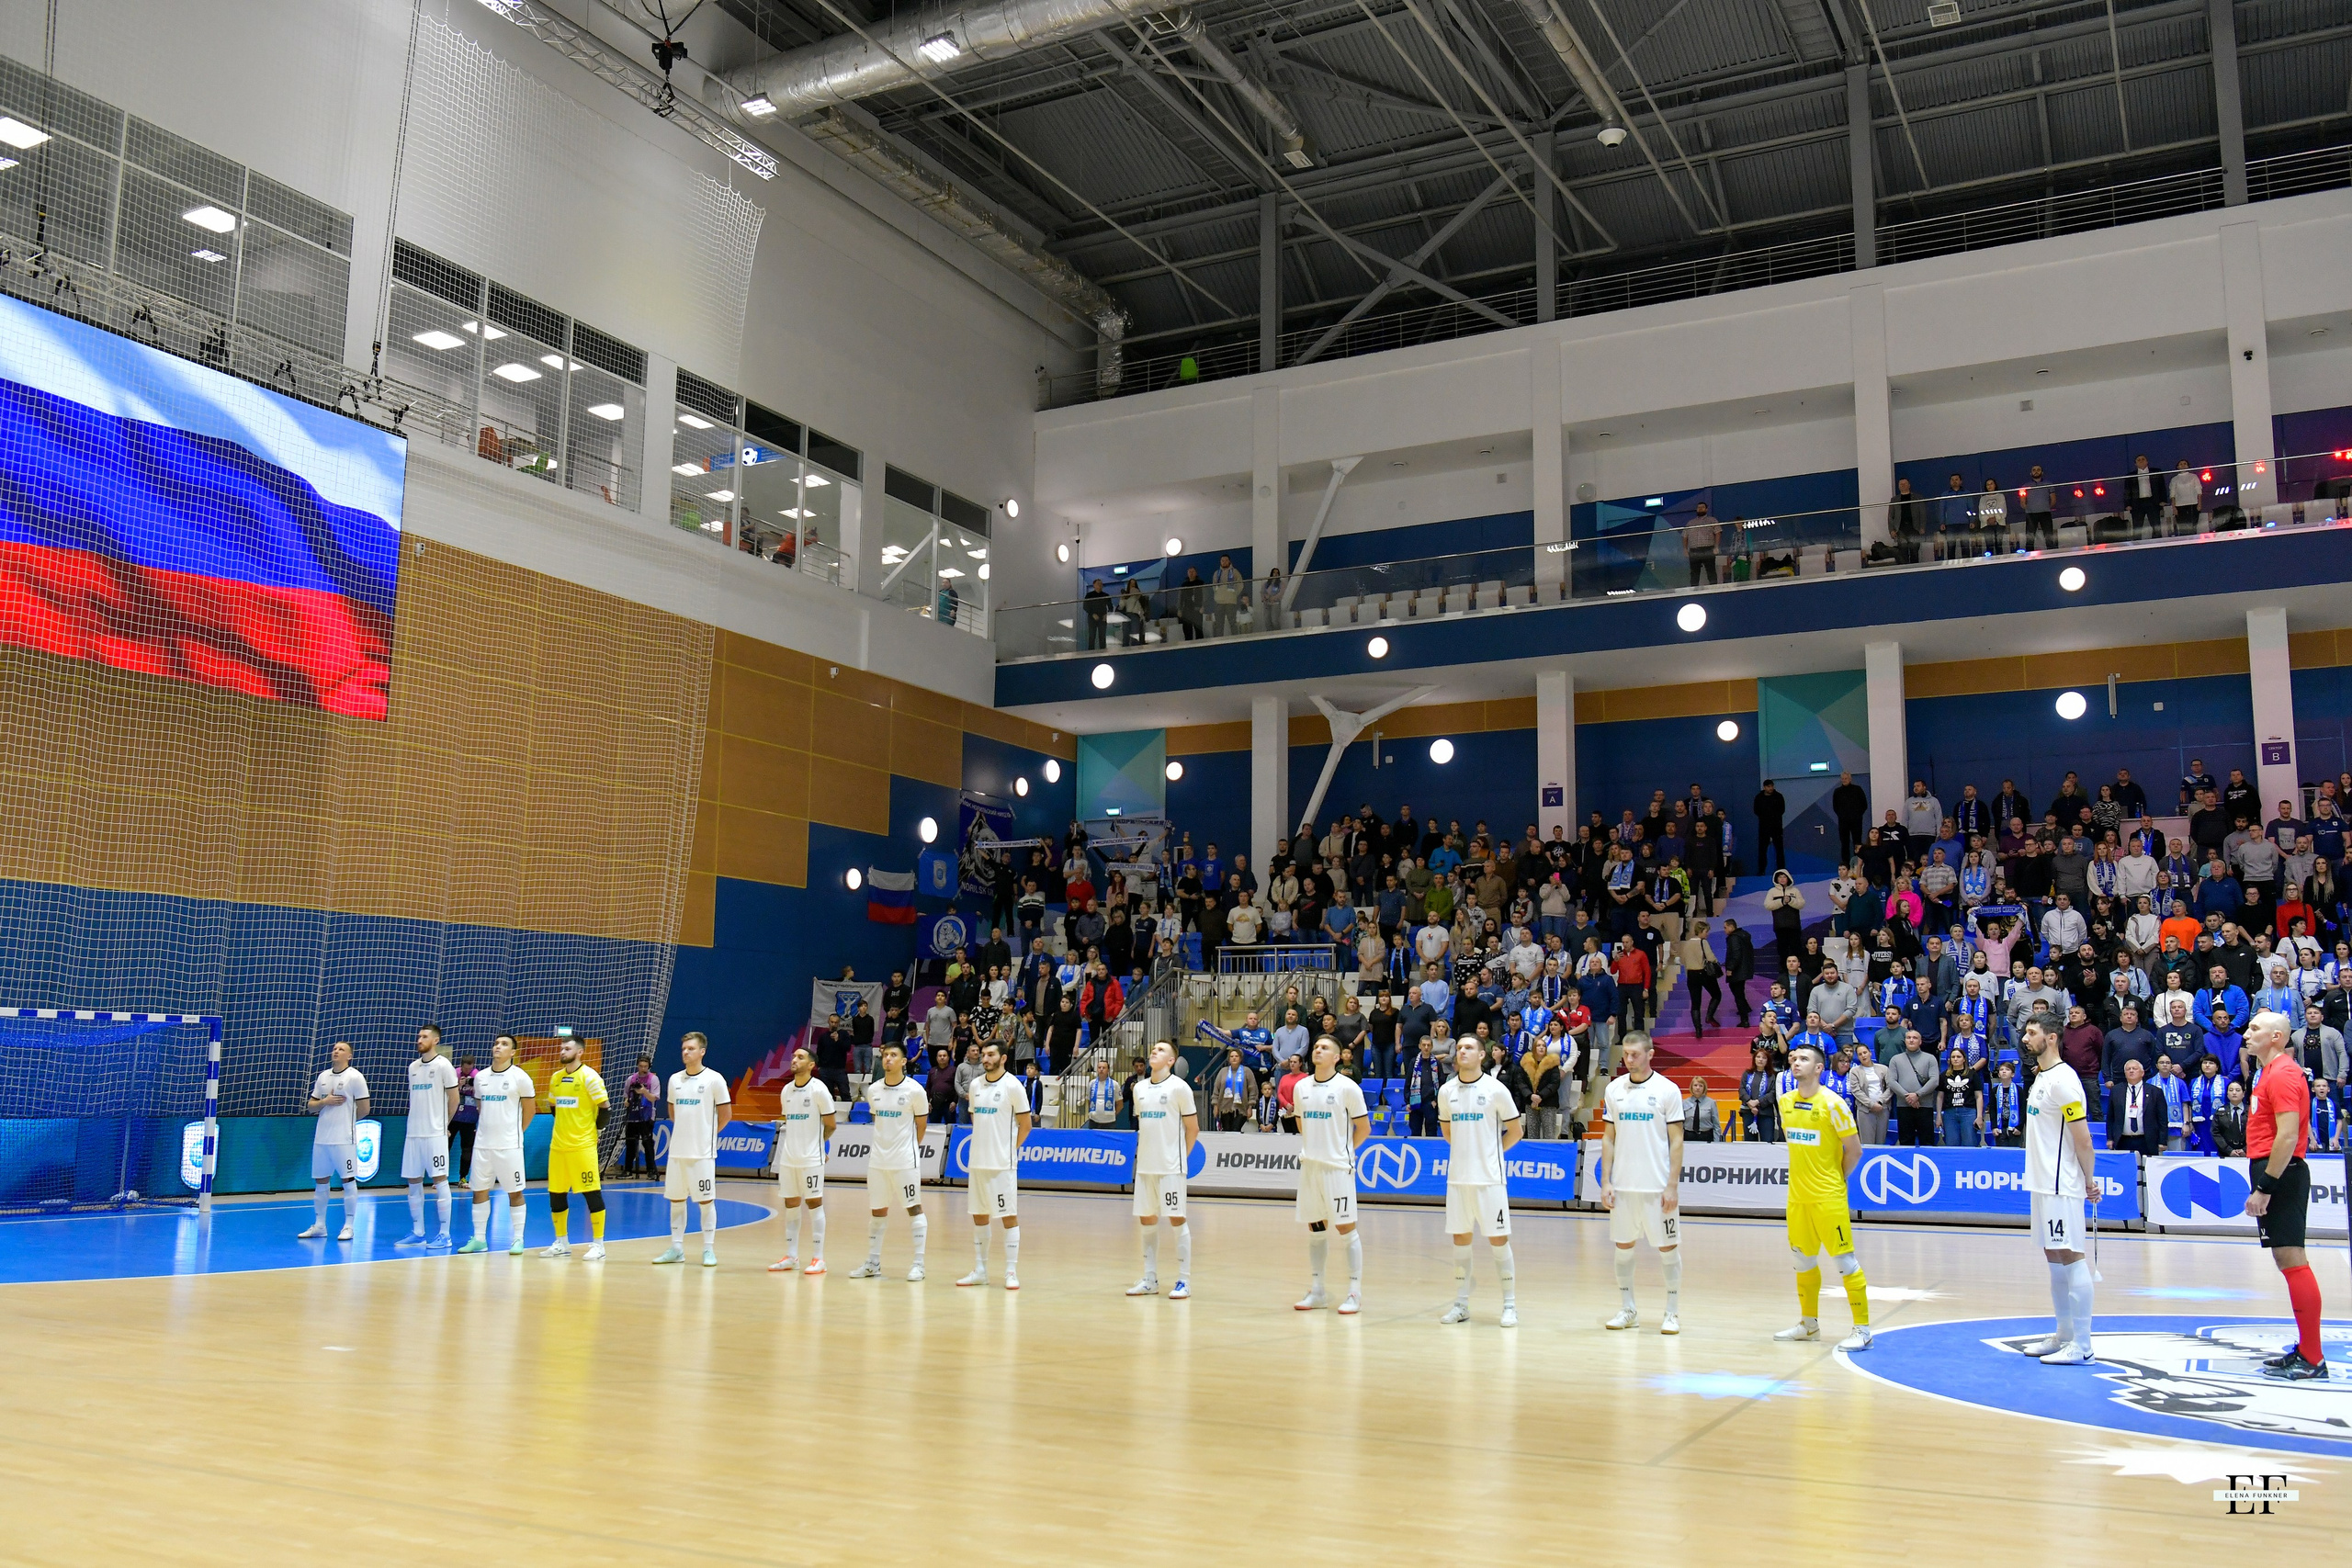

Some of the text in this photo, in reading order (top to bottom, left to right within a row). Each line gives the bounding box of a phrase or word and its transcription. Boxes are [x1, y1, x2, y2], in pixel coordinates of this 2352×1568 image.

[961, 881, 987, 895] NORILSK
[1140, 1111, 1166, 1119] СИБУР
[1303, 1111, 1332, 1120] СИБУР
[1452, 1112, 1484, 1122] СИБУР
[1619, 1111, 1654, 1122] СИБУР
[1787, 1131, 1816, 1142] СИБУР
[717, 1136, 765, 1153] ИКЕЛЬ
[837, 1144, 935, 1158] НОРЛЬ
[433, 1155, 446, 1168] 80
[1018, 1146, 1126, 1166] НОРНИКЕЛЬ
[1216, 1152, 1301, 1170] НОРНИК
[346, 1159, 353, 1170] 8
[1431, 1158, 1566, 1180] НКЕЛЬ
[514, 1171, 521, 1183] 9
[581, 1171, 594, 1183] 99
[806, 1175, 820, 1189] 97
[1679, 1166, 1790, 1186] НОРНИКЕ
[1955, 1170, 2124, 1196] НОРНЛЬ
[698, 1179, 711, 1192] 90
[903, 1184, 915, 1199] 18
[997, 1194, 1005, 1208] 5
[1165, 1191, 1178, 1206] 95
[1333, 1196, 1348, 1213] 77
[1497, 1209, 1504, 1224] 4
[1663, 1218, 1676, 1235] 12
[1836, 1224, 1844, 1242] 1
[2047, 1219, 2064, 1237] 14
